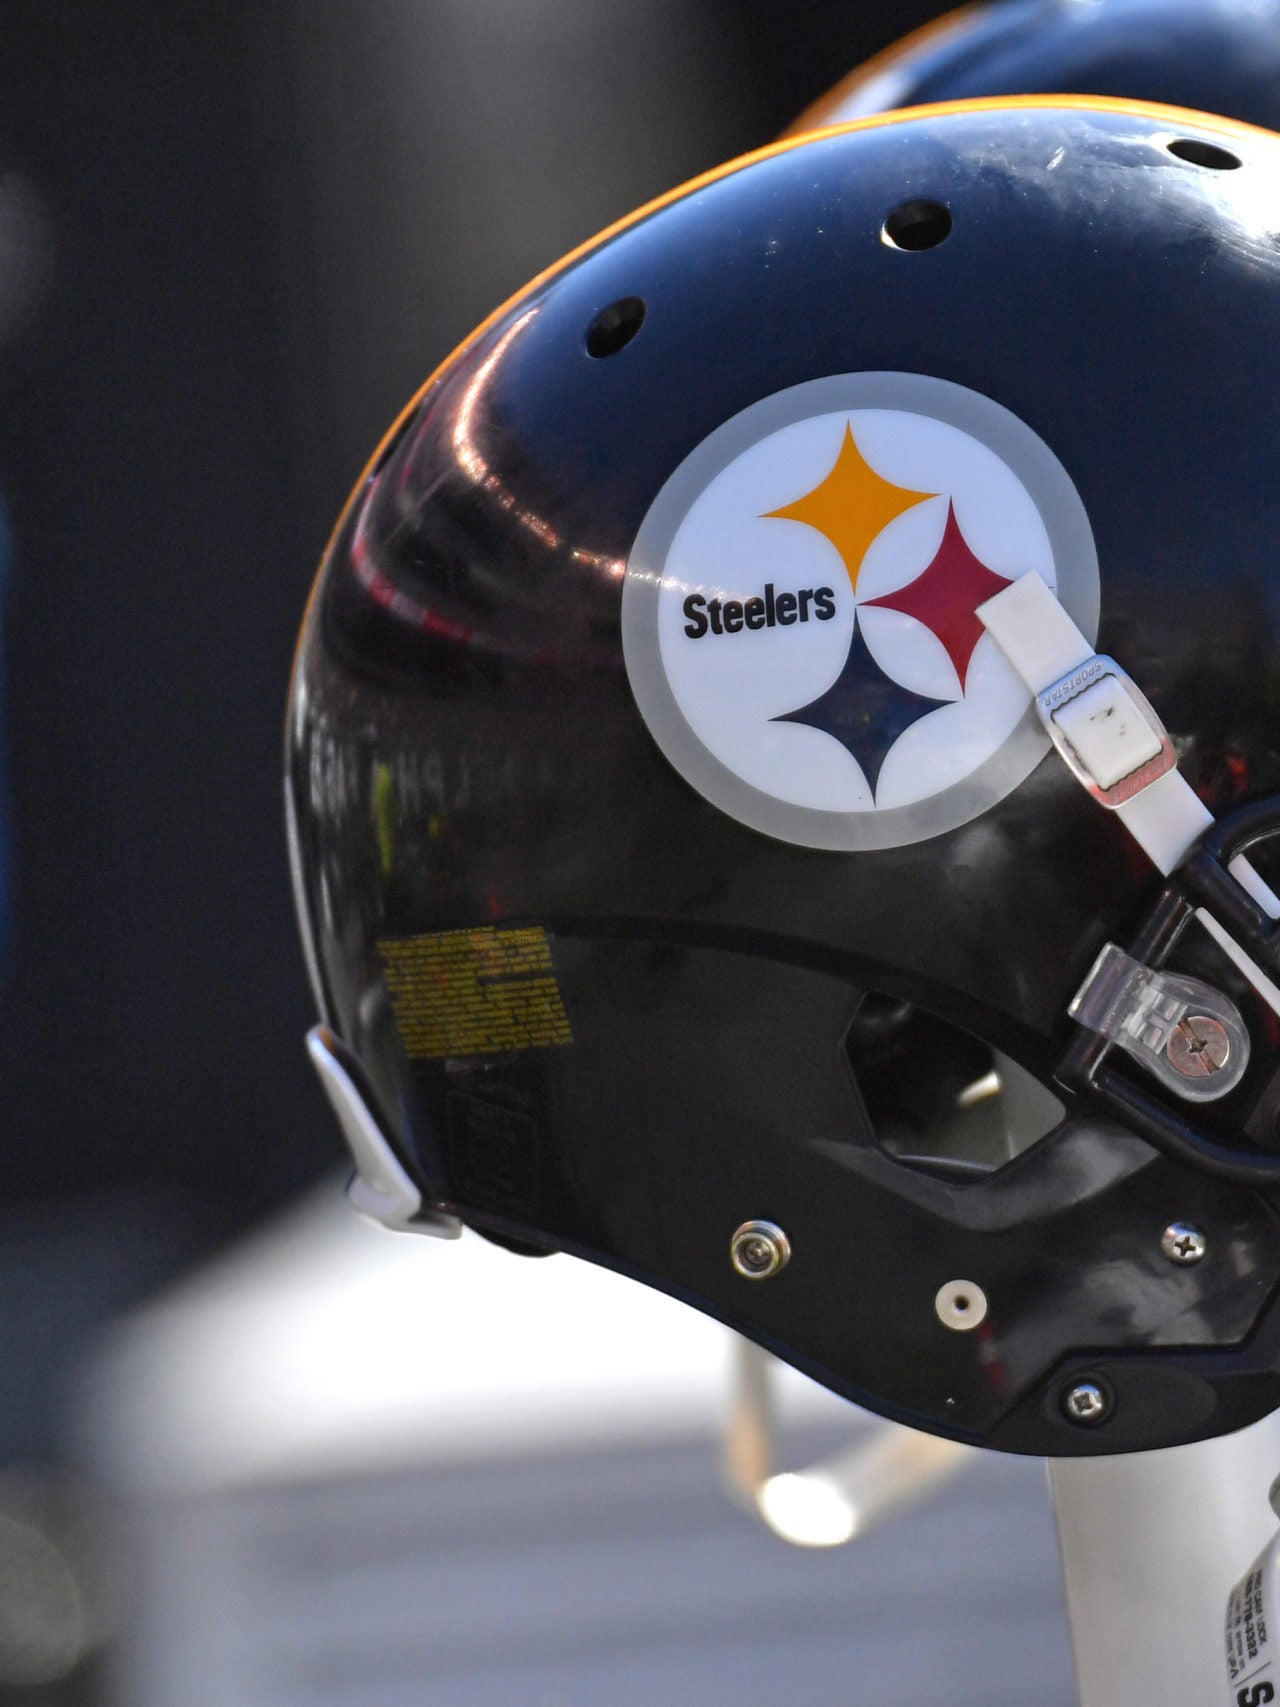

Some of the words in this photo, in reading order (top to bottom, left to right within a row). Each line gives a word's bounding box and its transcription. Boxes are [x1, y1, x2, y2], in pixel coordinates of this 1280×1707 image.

[683, 583, 836, 639] Steelers
[1045, 660, 1102, 706] SPORTSTAR
[1256, 1615, 1267, 1646] LOCK
